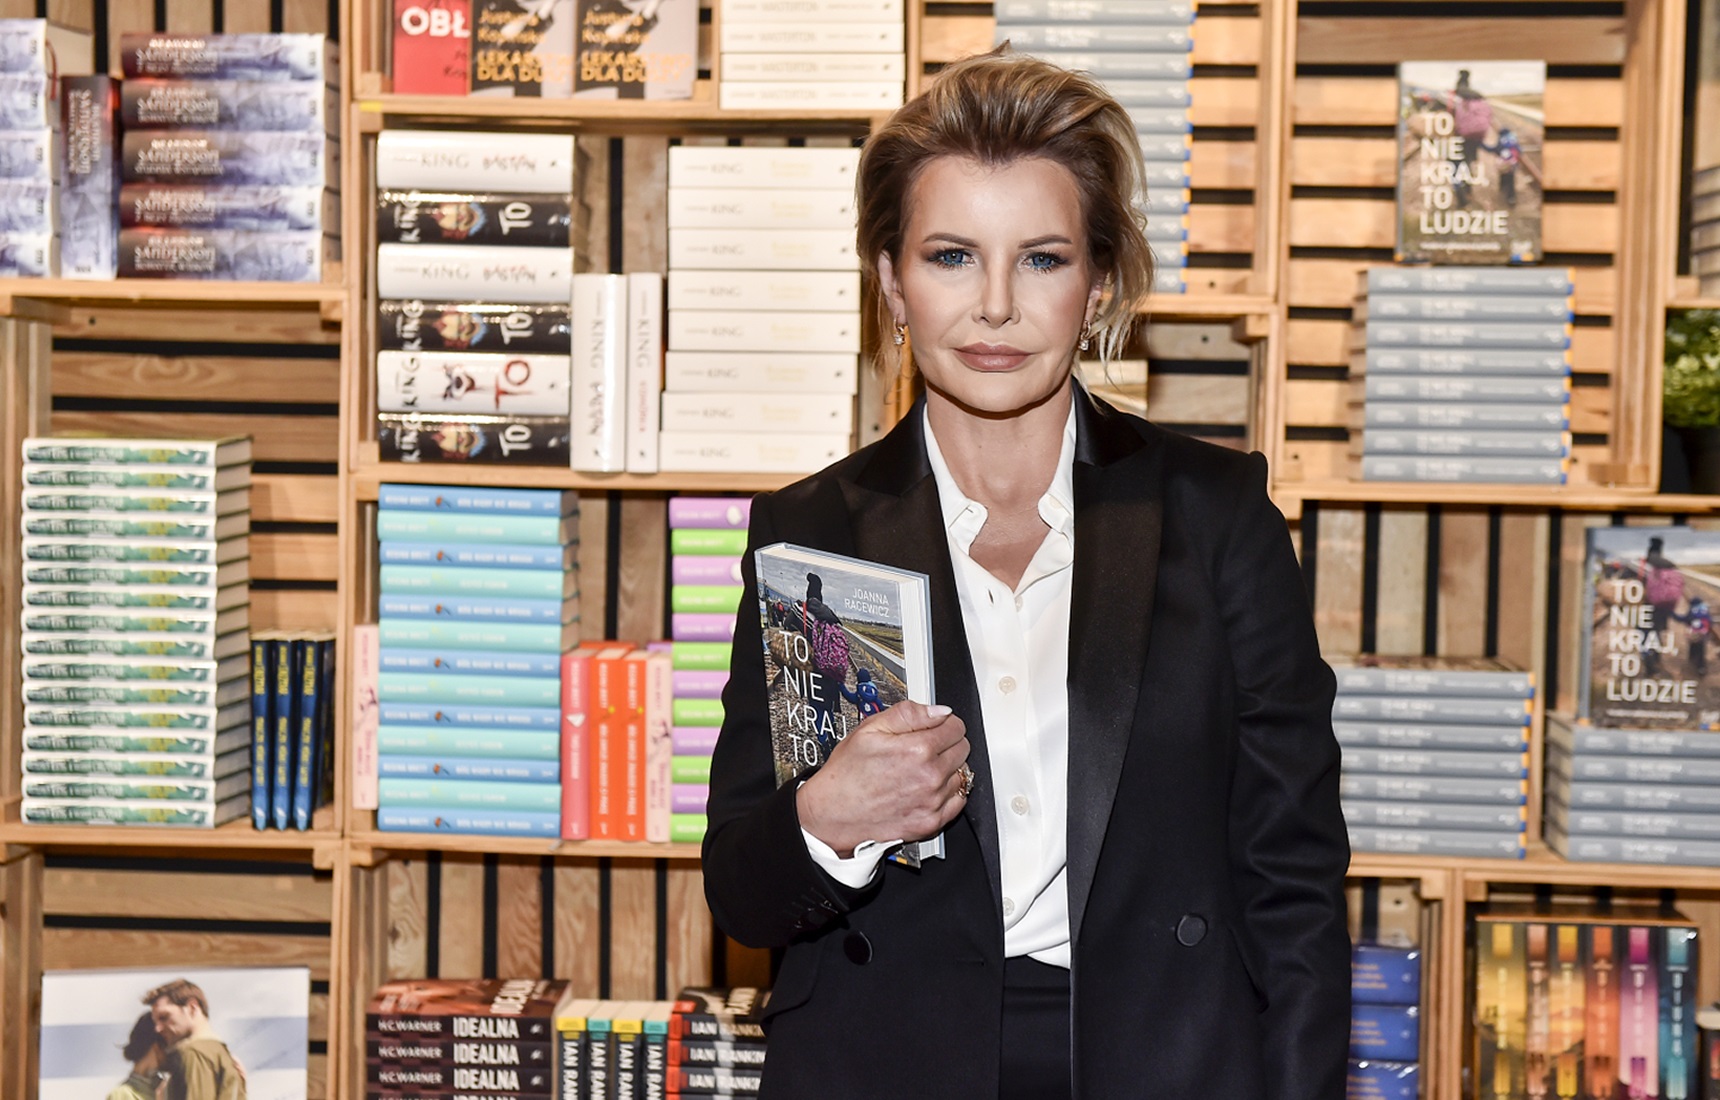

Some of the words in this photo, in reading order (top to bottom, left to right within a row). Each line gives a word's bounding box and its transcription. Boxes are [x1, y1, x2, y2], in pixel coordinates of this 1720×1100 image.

[401, 6, 471, 38] OBŁ
[581, 67, 620, 81] DLA
[1419, 112, 1455, 135] TO
[1420, 136, 1465, 160] NIE
[1419, 186, 1453, 209] TO
[498, 202, 532, 235] TO
[1419, 210, 1510, 235] LUDZIE
[500, 312, 534, 345] TO
[401, 356, 421, 408] KING
[493, 359, 535, 411] TO
[499, 424, 533, 457] TO
[852, 587, 890, 605] JOANNA
[1611, 579, 1645, 604] TO
[844, 598, 890, 618] RACEWICZ
[1610, 605, 1655, 629] NIE
[779, 630, 809, 663] TO
[1608, 653, 1641, 677] TO
[783, 665, 825, 702] NIE
[1606, 679, 1699, 704] LUDZIE
[790, 734, 819, 766] TO
[453, 1016, 520, 1039] IDEALNA
[691, 1021, 717, 1035] IAN
[453, 1043, 520, 1065] IDEALNA
[563, 1041, 578, 1066] IAN
[590, 1042, 606, 1067] IAN
[619, 1044, 634, 1069] IAN
[647, 1045, 662, 1070] IAN
[690, 1048, 716, 1061] IAN
[453, 1068, 520, 1091] IDEALNA
[689, 1074, 715, 1088] IAN
